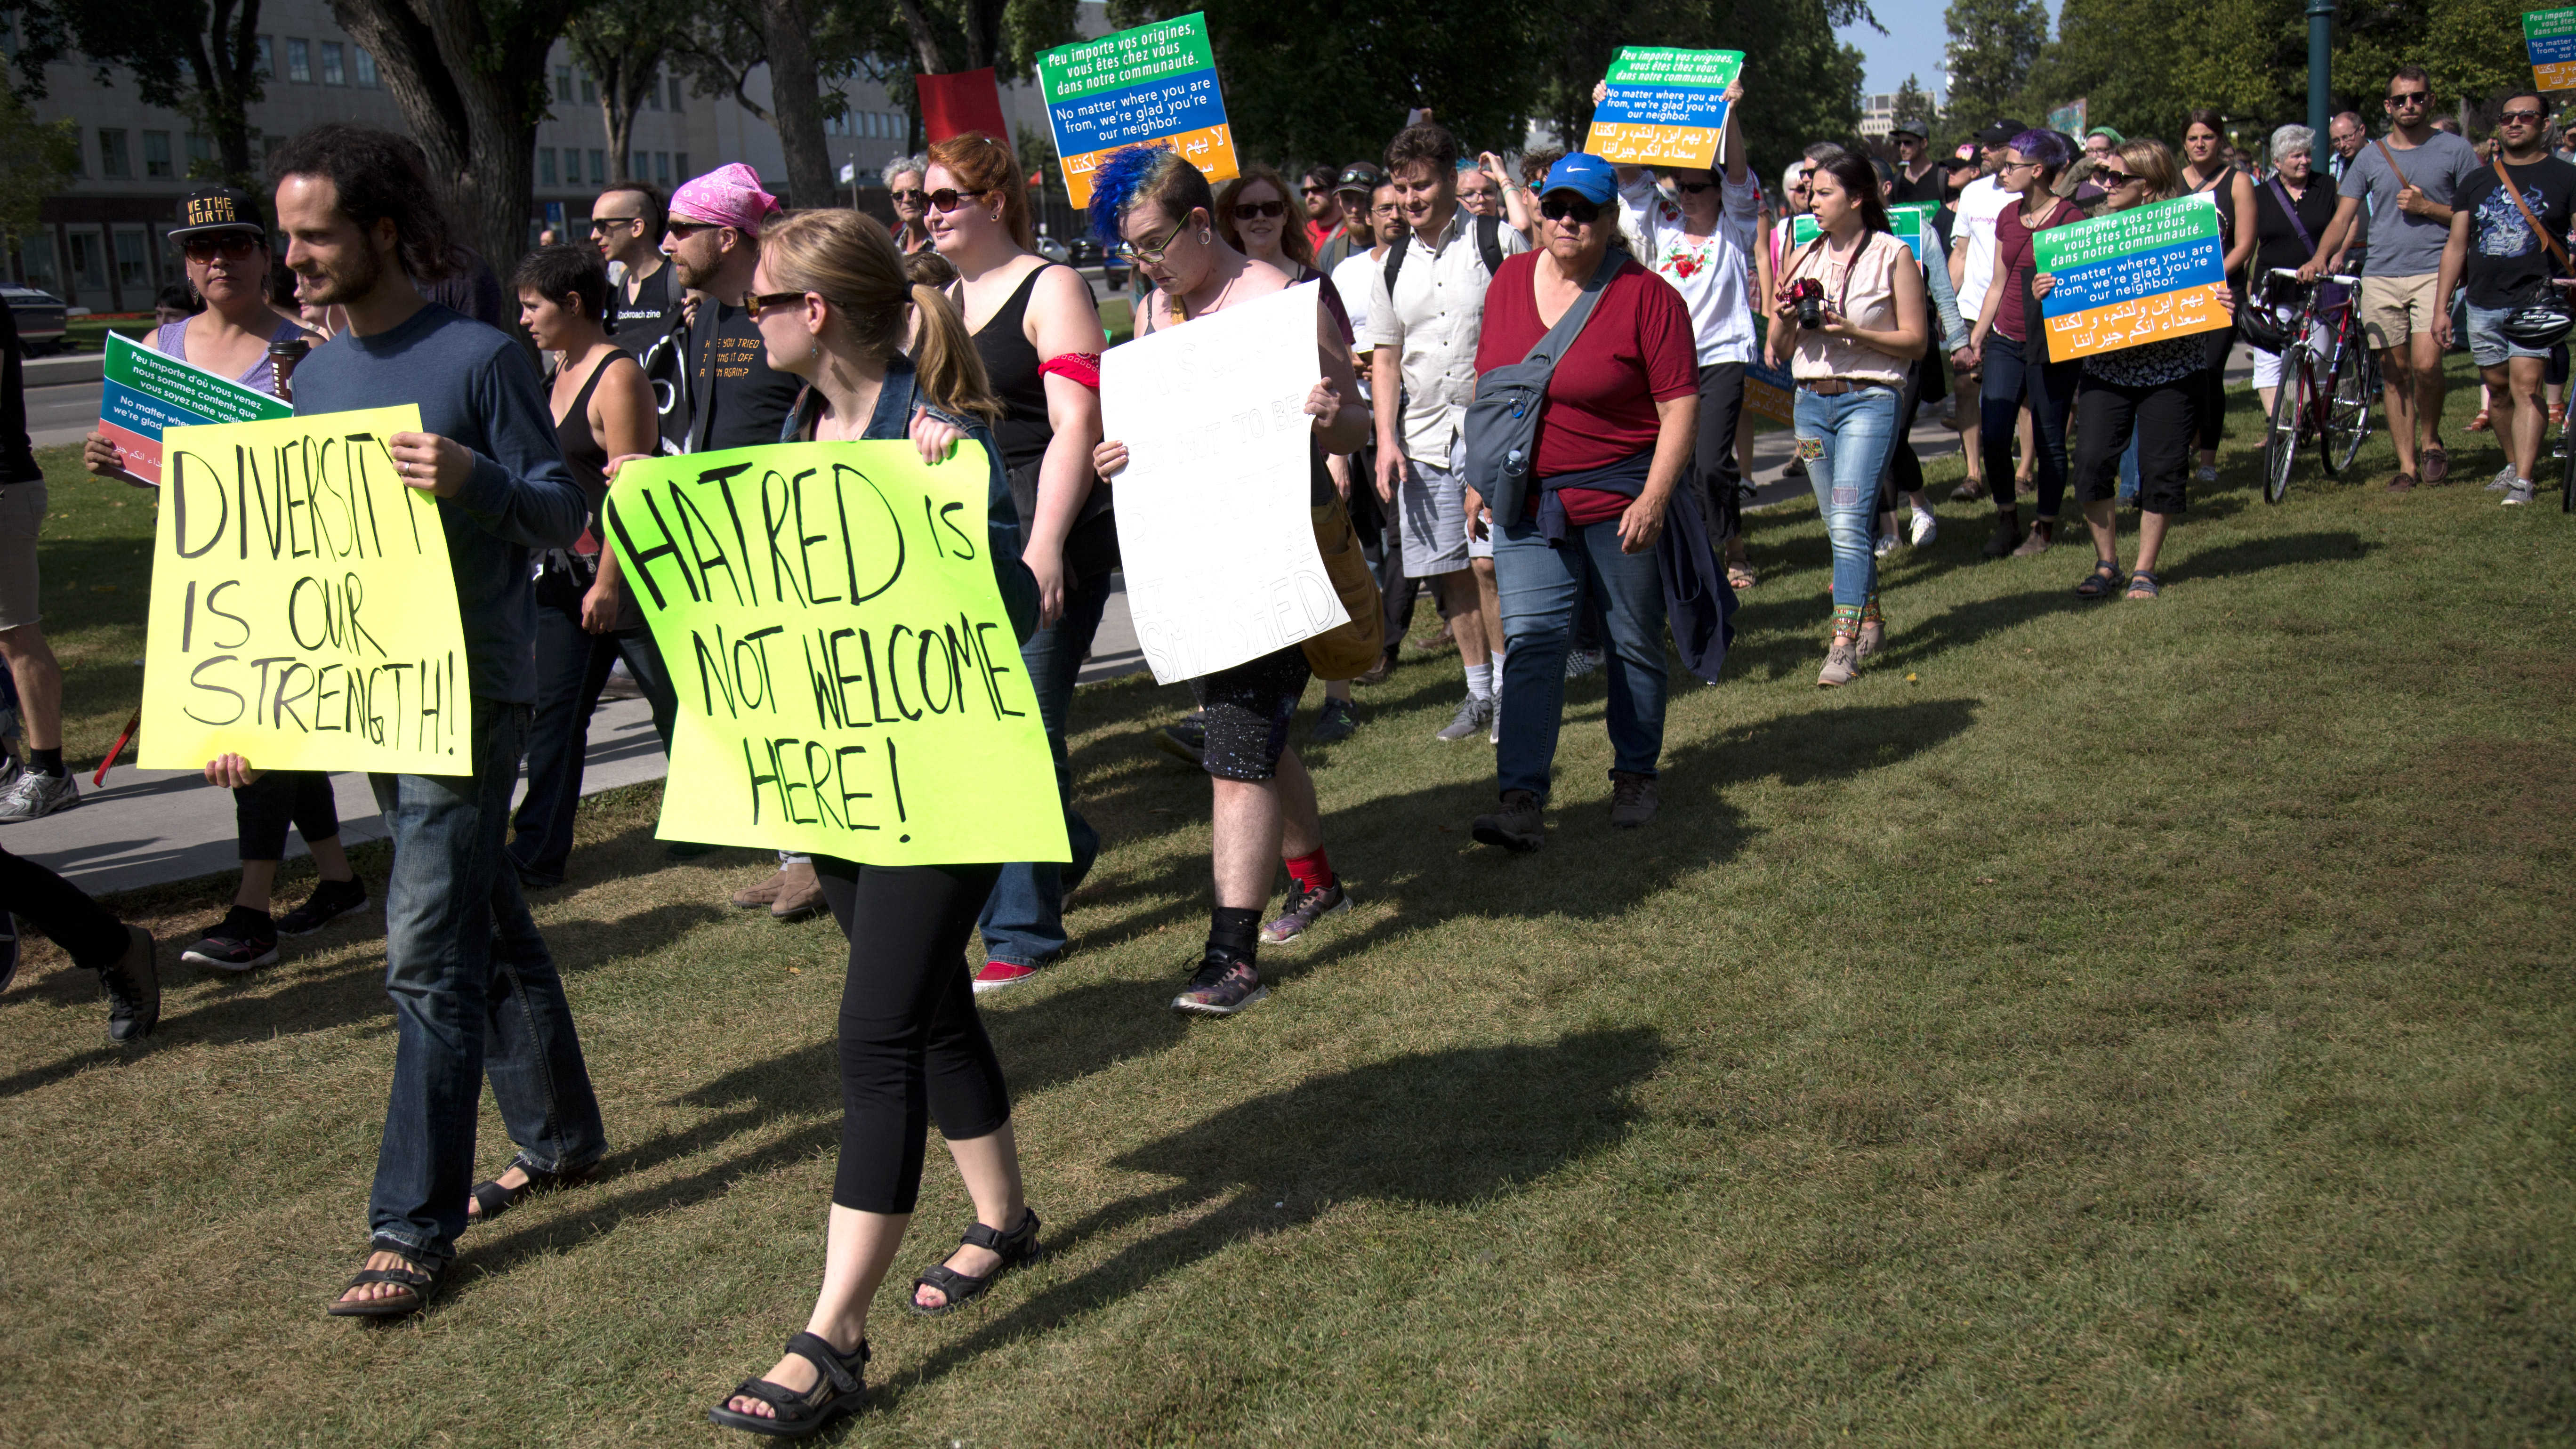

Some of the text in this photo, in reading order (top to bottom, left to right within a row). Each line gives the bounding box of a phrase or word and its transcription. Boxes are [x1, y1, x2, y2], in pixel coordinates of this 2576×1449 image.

[2545, 10, 2573, 20] importe
[1049, 24, 1195, 67] Peu importe vos origines,
[1067, 42, 1180, 78] vous êtes chez vous
[1620, 50, 1733, 65] Peu importe vos origines,
[1630, 61, 1717, 73] vous êtes chez vous
[1057, 51, 1199, 95] dans notre communauté.
[1616, 71, 1724, 84] dans notre communauté.
[1057, 80, 1210, 121] No matter where you are
[1607, 89, 1619, 98] No
[1622, 89, 1653, 99] matter
[1657, 90, 1684, 100] where
[1688, 93, 1705, 104] you
[1607, 98, 1716, 113] from, we're glad you're
[1065, 95, 1207, 133] from, we're glad you're
[1627, 110, 1690, 122] our neighbor.
[1099, 116, 1181, 140] our neighbor.
[1211, 127, 1224, 146] لا
[1595, 123, 1617, 137] لكننا
[1618, 130, 1626, 141] و
[1662, 128, 1681, 144] اين
[1682, 132, 1701, 145] يهم
[1706, 129, 1716, 144] لا
[1186, 137, 1209, 160] يهم
[1639, 145, 1660, 161] انكم
[1664, 146, 1696, 159] سعداء
[187, 197, 233, 214] WE THE
[189, 210, 236, 226] NORTH
[2045, 200, 2203, 244] Peu importe vos origines,
[2064, 217, 2185, 251] vous êtes chez vous
[2051, 225, 2203, 267] dans notre communauté.
[2057, 244, 2213, 286] o matter where you are
[2054, 258, 2207, 298] from, we're glad you're
[2089, 277, 2178, 302] our neighbor.
[646, 309, 660, 318] zine
[2152, 294, 2174, 316] اين
[2180, 293, 2204, 312] يهم
[2052, 312, 2083, 332] لكننا
[2092, 316, 2099, 329] و
[2128, 319, 2155, 343] انكم
[2162, 314, 2206, 331] سعداء
[723, 338, 735, 347] YOU
[738, 338, 760, 348] TRIED
[731, 353, 736, 362] IT
[738, 353, 754, 362] OFF
[131, 351, 263, 411] Peu importe d'où vous venez,
[724, 368, 749, 379] AGAIN?
[133, 366, 257, 420] nous sommes contents que
[141, 381, 162, 394] vous
[164, 392, 190, 408] soyez
[192, 402, 216, 415] notre
[113, 406, 162, 430] we're glad
[120, 396, 133, 407] No
[136, 402, 165, 419] matter
[1132, 393, 1303, 475] IS NOT TO BE
[129, 451, 145, 461] انكم
[607, 462, 975, 612] HATRED IS
[182, 572, 387, 657] IS OUR
[1140, 570, 1336, 684] SMASHED
[692, 612, 1025, 730] NOT WELCOME
[183, 650, 454, 756] STRENGTH!
[743, 737, 911, 844] HERE!
